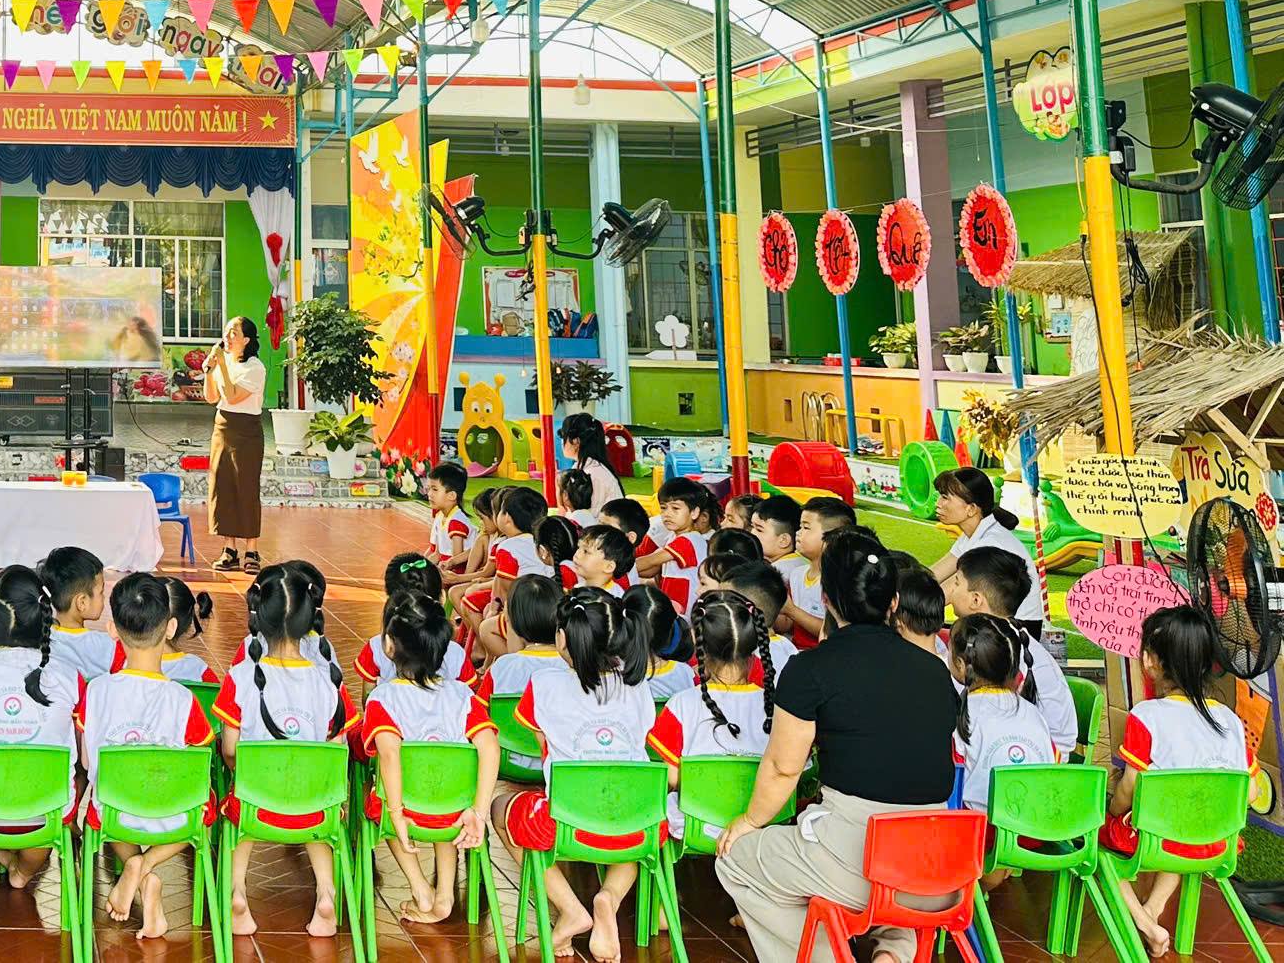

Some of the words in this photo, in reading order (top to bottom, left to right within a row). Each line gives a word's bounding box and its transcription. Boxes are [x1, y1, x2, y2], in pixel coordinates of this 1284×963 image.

[2, 103, 57, 130] NGHĨA
[59, 103, 101, 135] VIỆT
[105, 109, 143, 132] NAM
[146, 104, 196, 133] MUÔN
[199, 105, 238, 132] NĂM
[1181, 445, 1211, 481] Trà
[1214, 450, 1251, 496] Sữa
